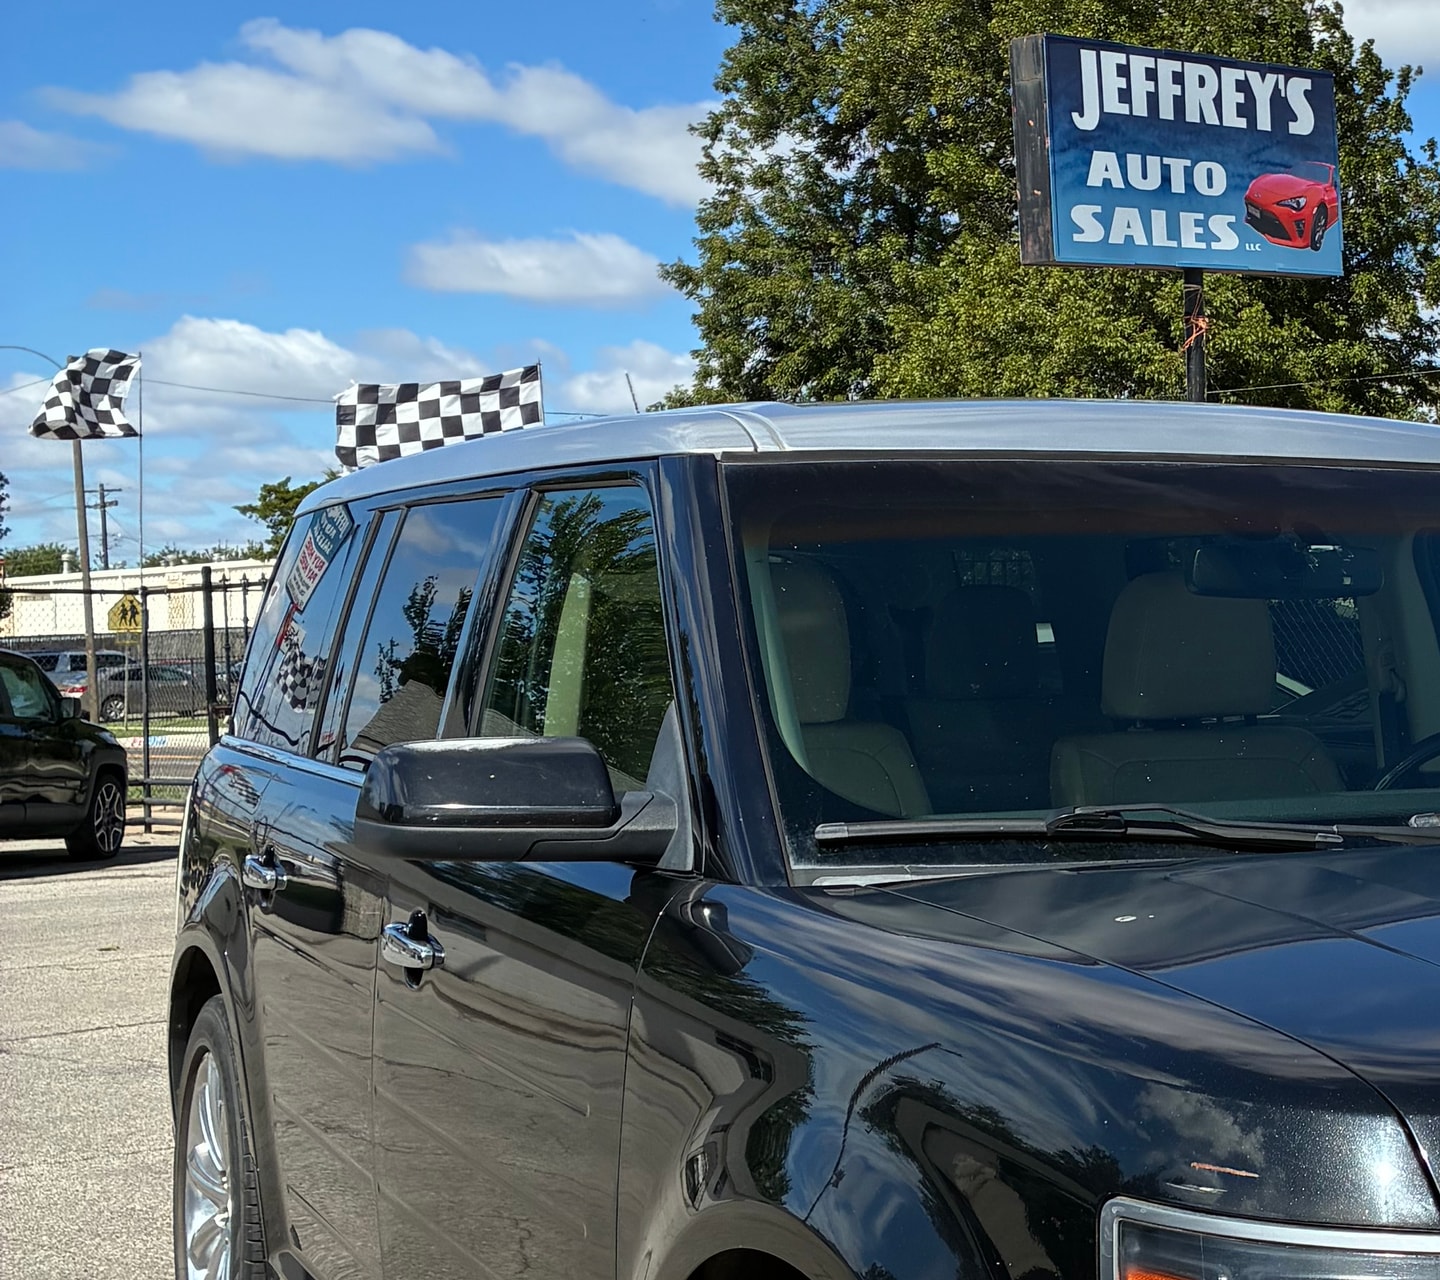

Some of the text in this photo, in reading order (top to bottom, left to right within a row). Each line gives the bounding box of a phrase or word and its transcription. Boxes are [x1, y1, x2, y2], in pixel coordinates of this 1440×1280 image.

[1071, 48, 1315, 136] JEFFREY'S
[1086, 150, 1227, 197] AUTO
[1070, 204, 1262, 252] SALES LLC
